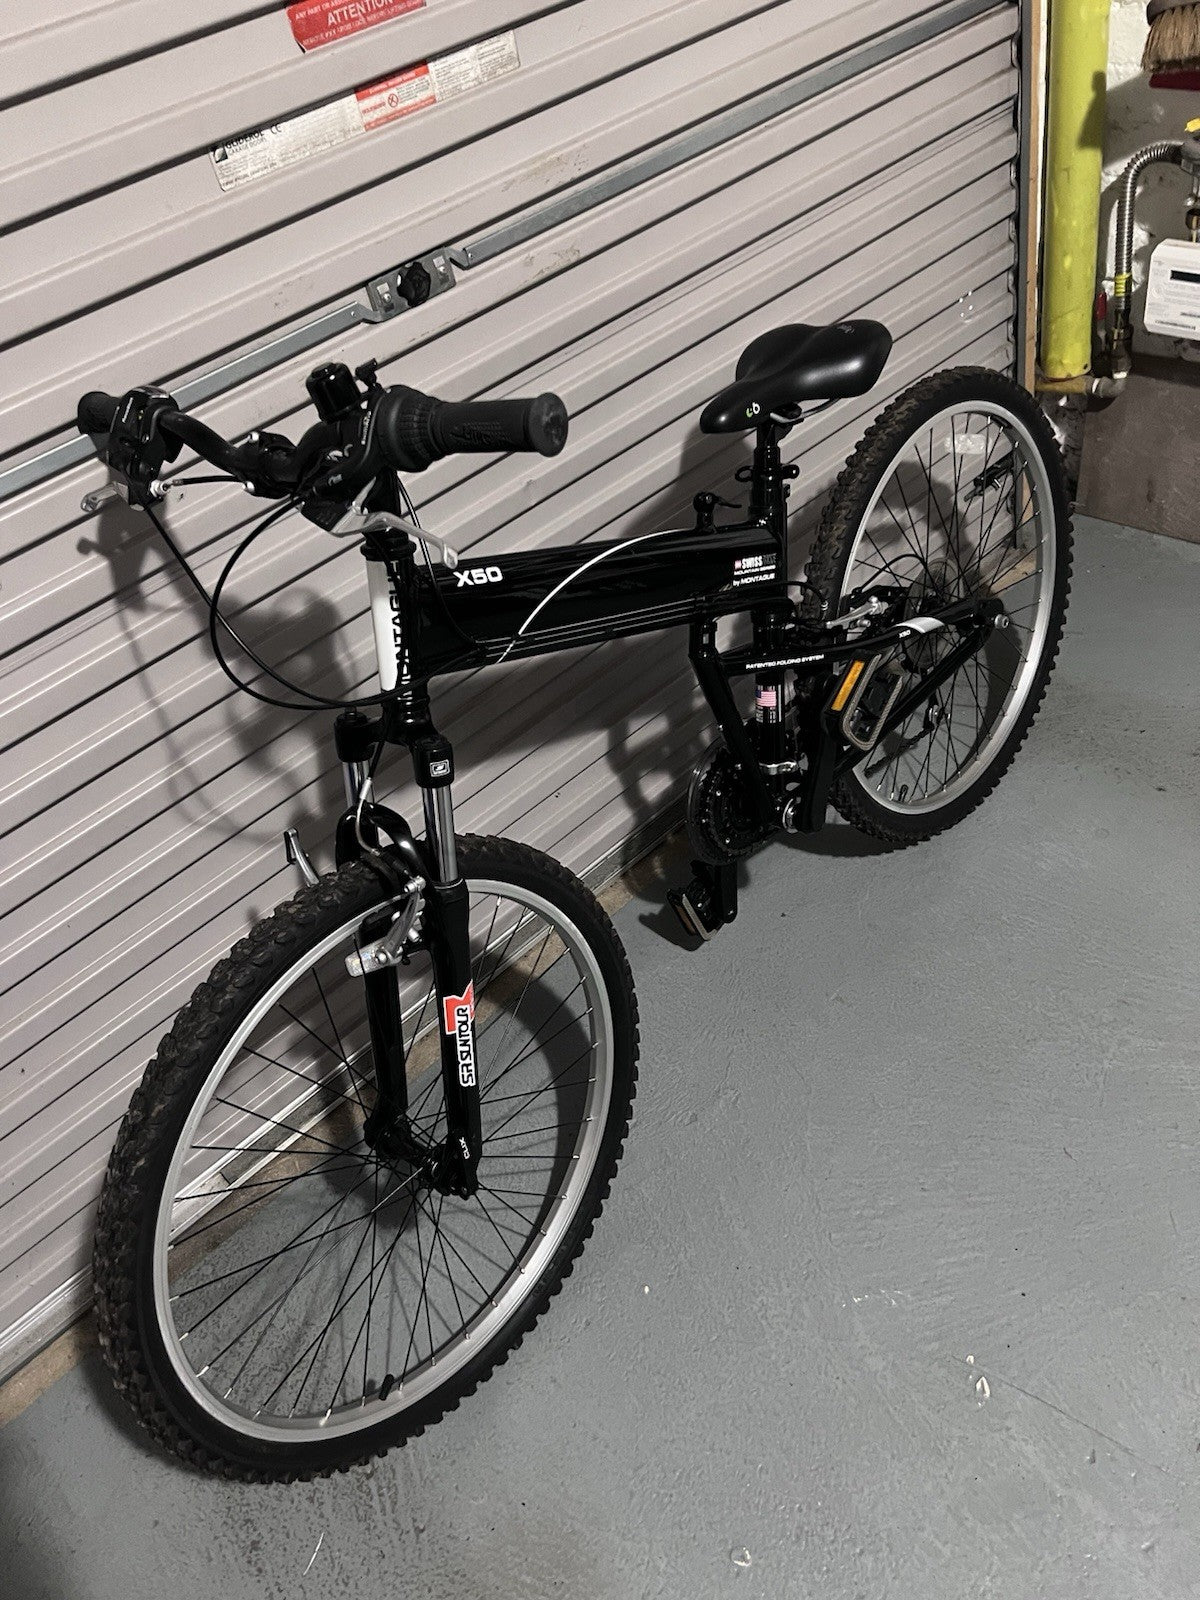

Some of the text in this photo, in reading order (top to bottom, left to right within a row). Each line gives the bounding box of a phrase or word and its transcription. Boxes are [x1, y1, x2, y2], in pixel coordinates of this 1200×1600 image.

[453, 566, 503, 587] X50
[740, 573, 775, 584] MONTAGUE
[745, 661, 776, 669] PATENTED
[801, 654, 824, 662] SYSTEM
[457, 1007, 473, 1084] SR SUNTOUR
